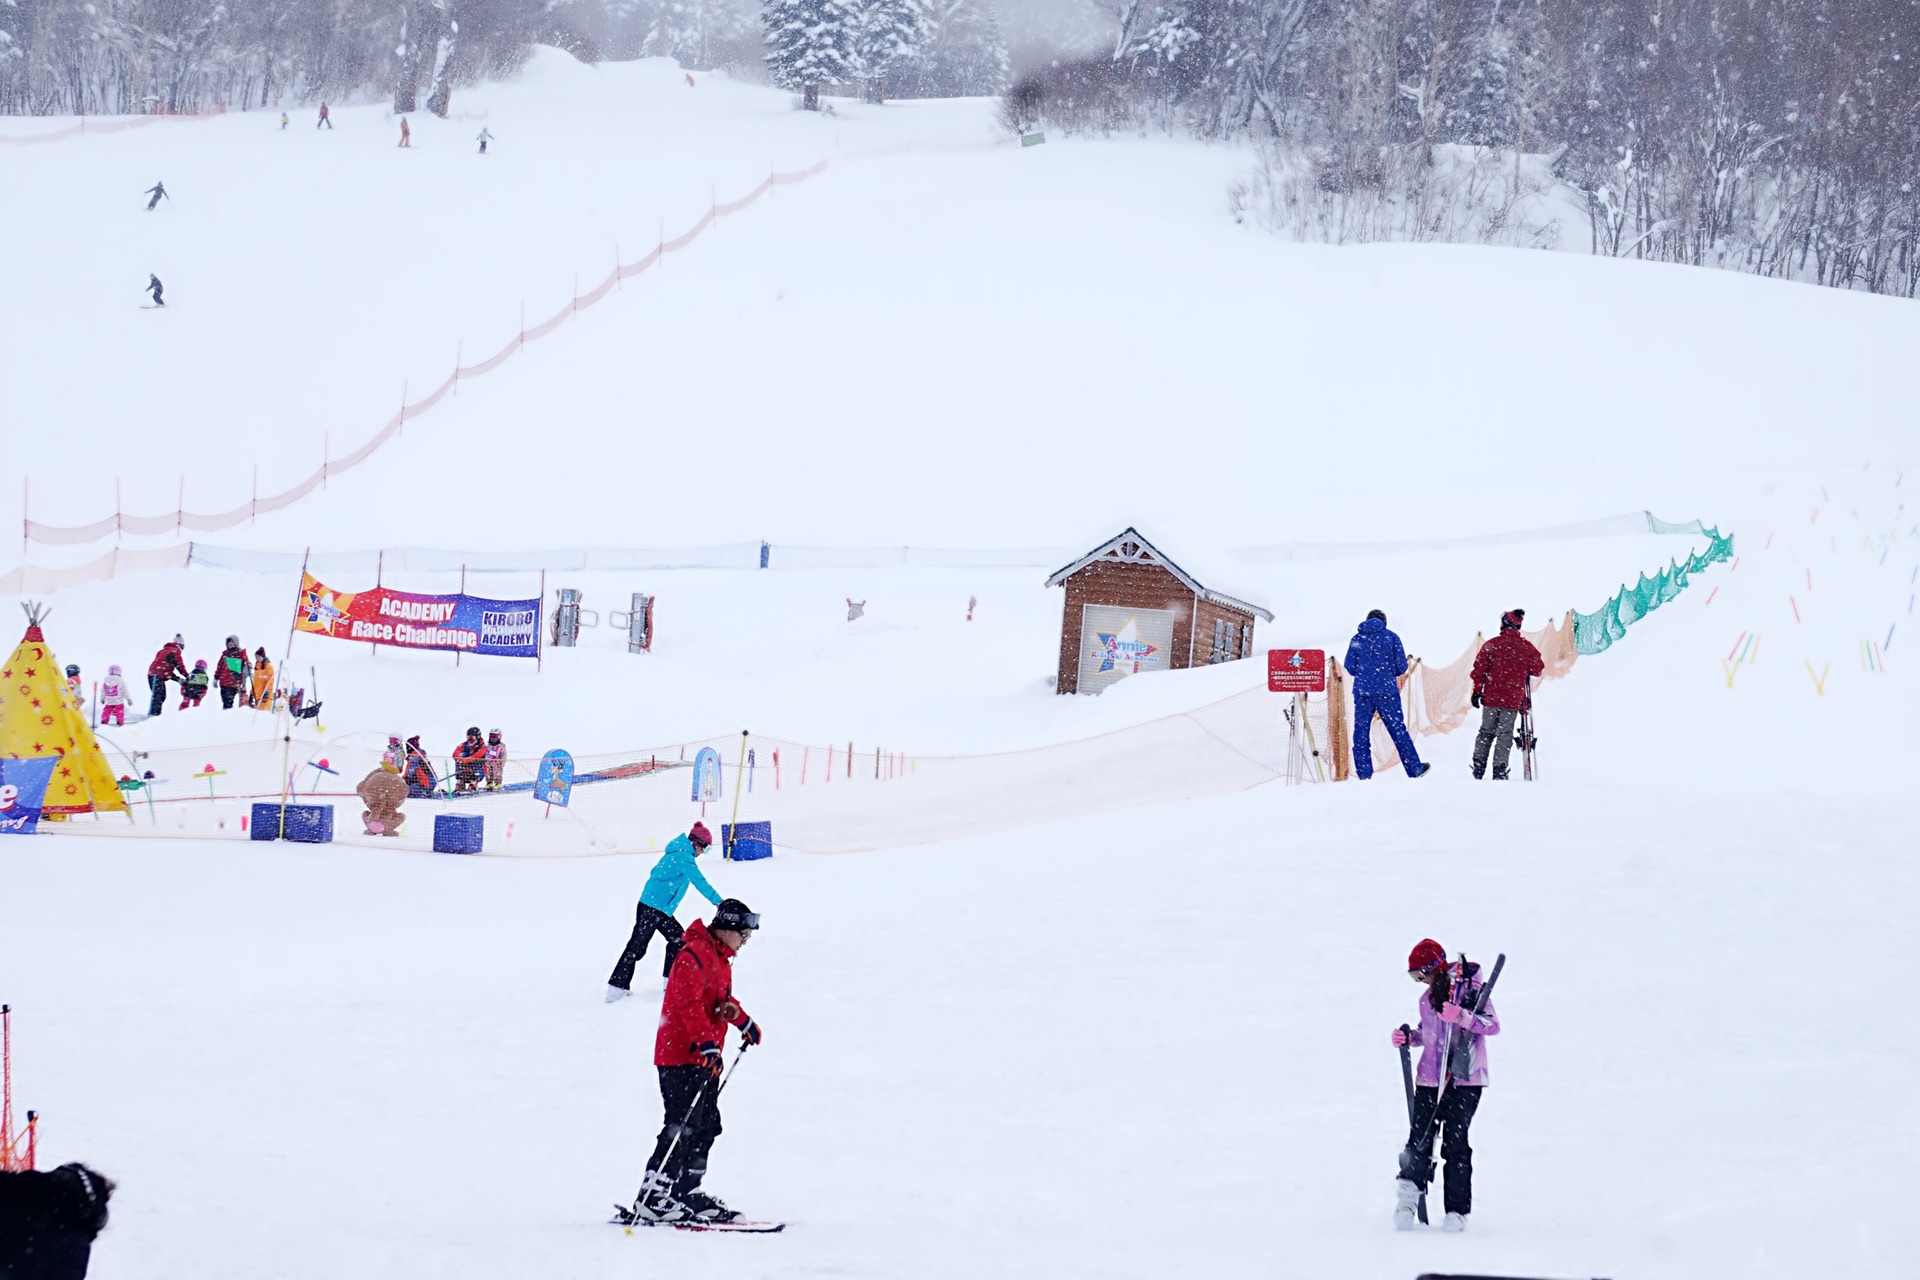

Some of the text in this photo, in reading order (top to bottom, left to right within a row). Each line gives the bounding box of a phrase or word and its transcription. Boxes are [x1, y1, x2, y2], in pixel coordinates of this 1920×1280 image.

[379, 597, 456, 621] ACADEMY
[483, 611, 533, 626] KIRORO
[351, 620, 477, 648] Race Challenge
[482, 634, 532, 645] ACADEMY
[1104, 637, 1147, 652] Annie
